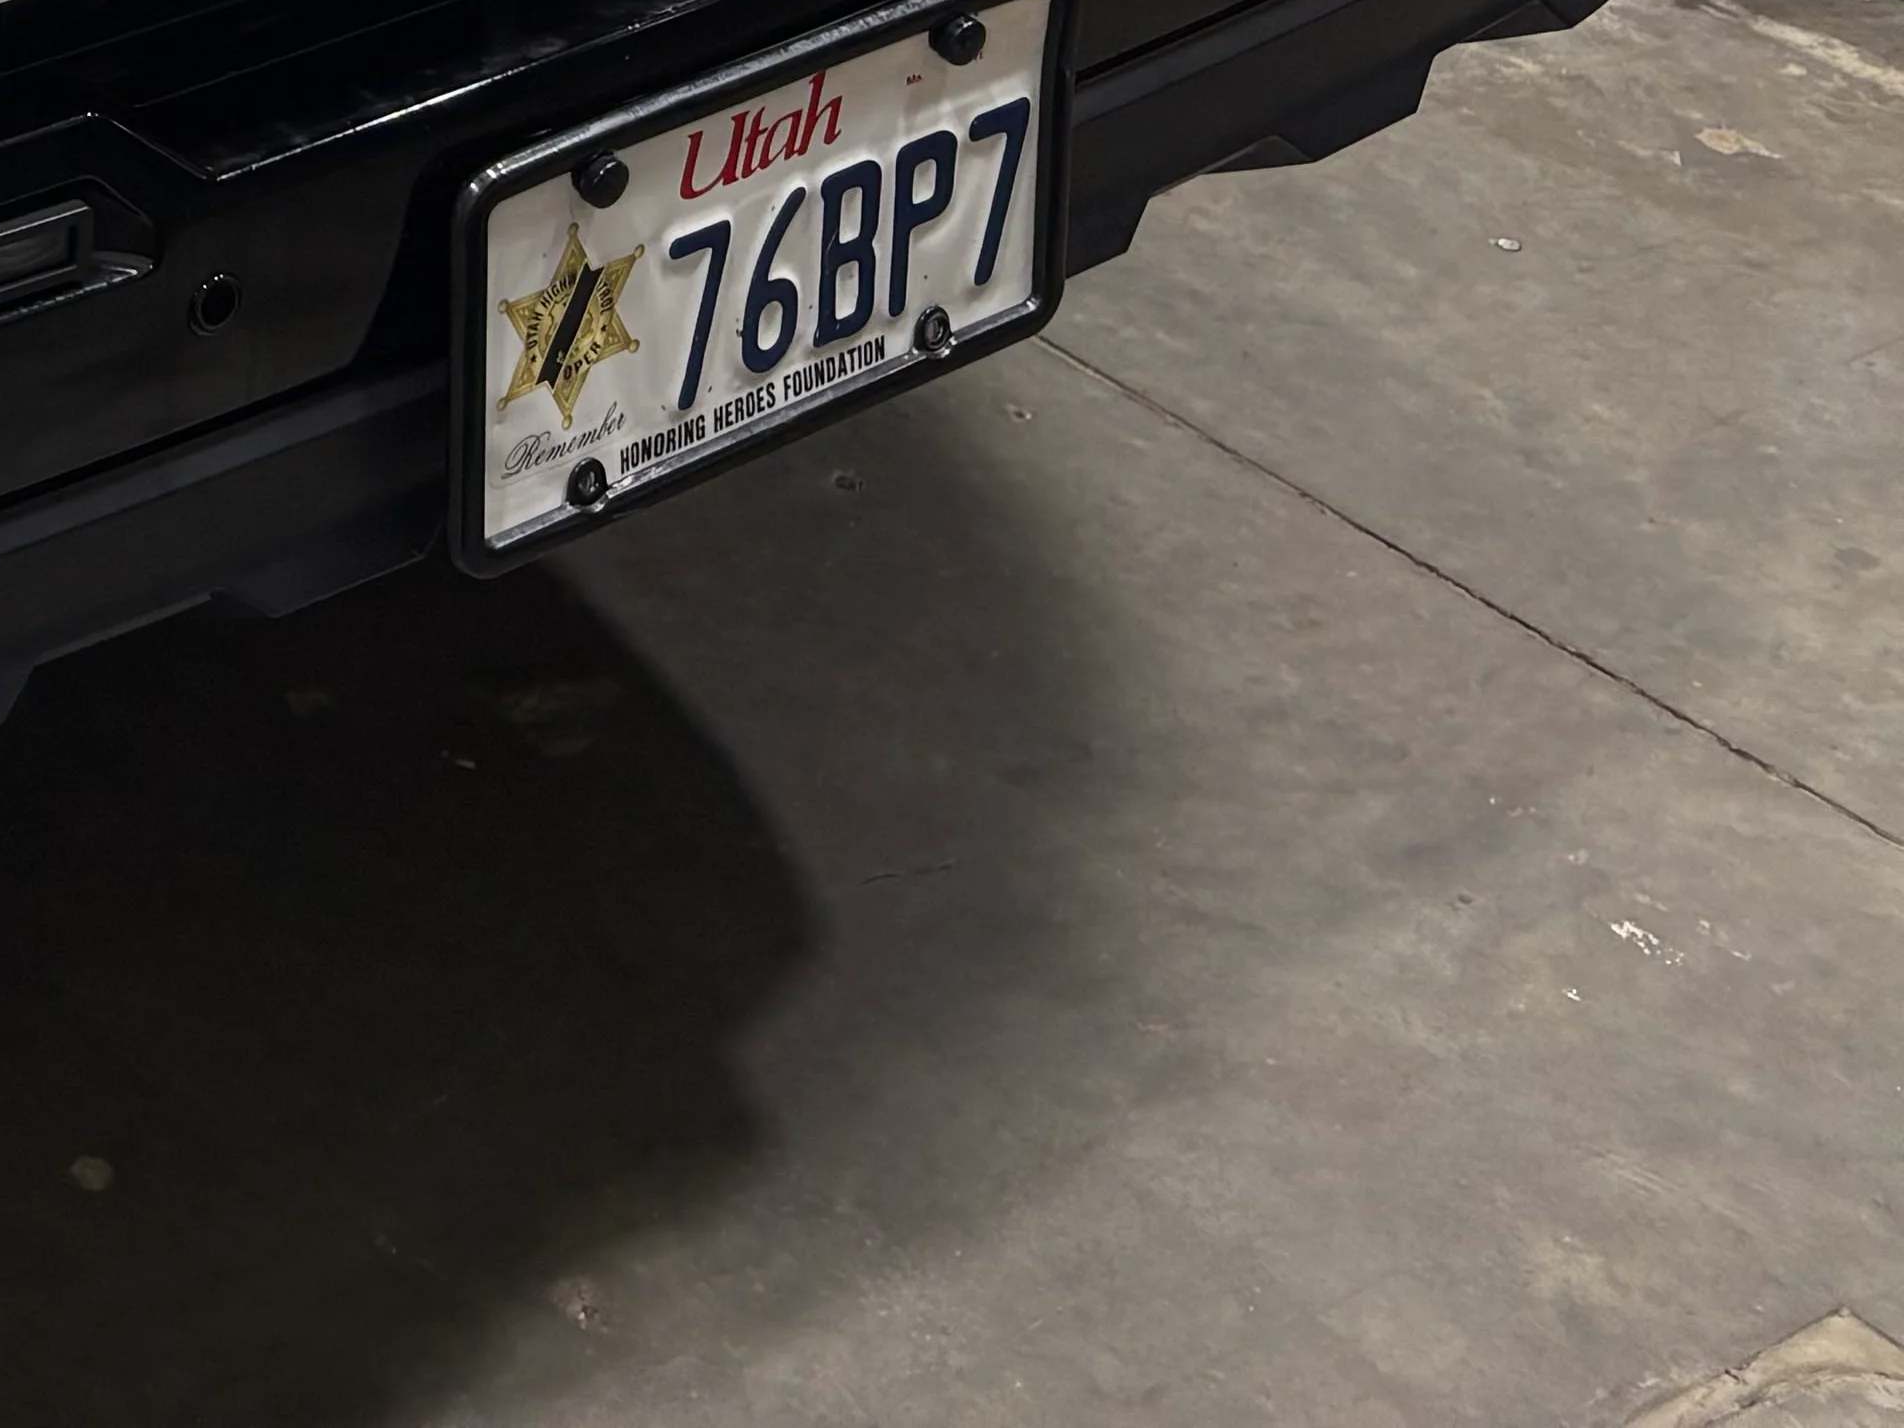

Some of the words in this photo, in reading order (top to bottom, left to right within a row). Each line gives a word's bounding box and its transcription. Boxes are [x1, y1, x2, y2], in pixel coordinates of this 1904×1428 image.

[680, 69, 843, 200] Utah
[669, 97, 1031, 412] 76BP7
[501, 401, 625, 480] Remember
[619, 414, 707, 474] HONORING
[713, 381, 776, 432] HEROES
[783, 335, 886, 402] FOUNDATION
